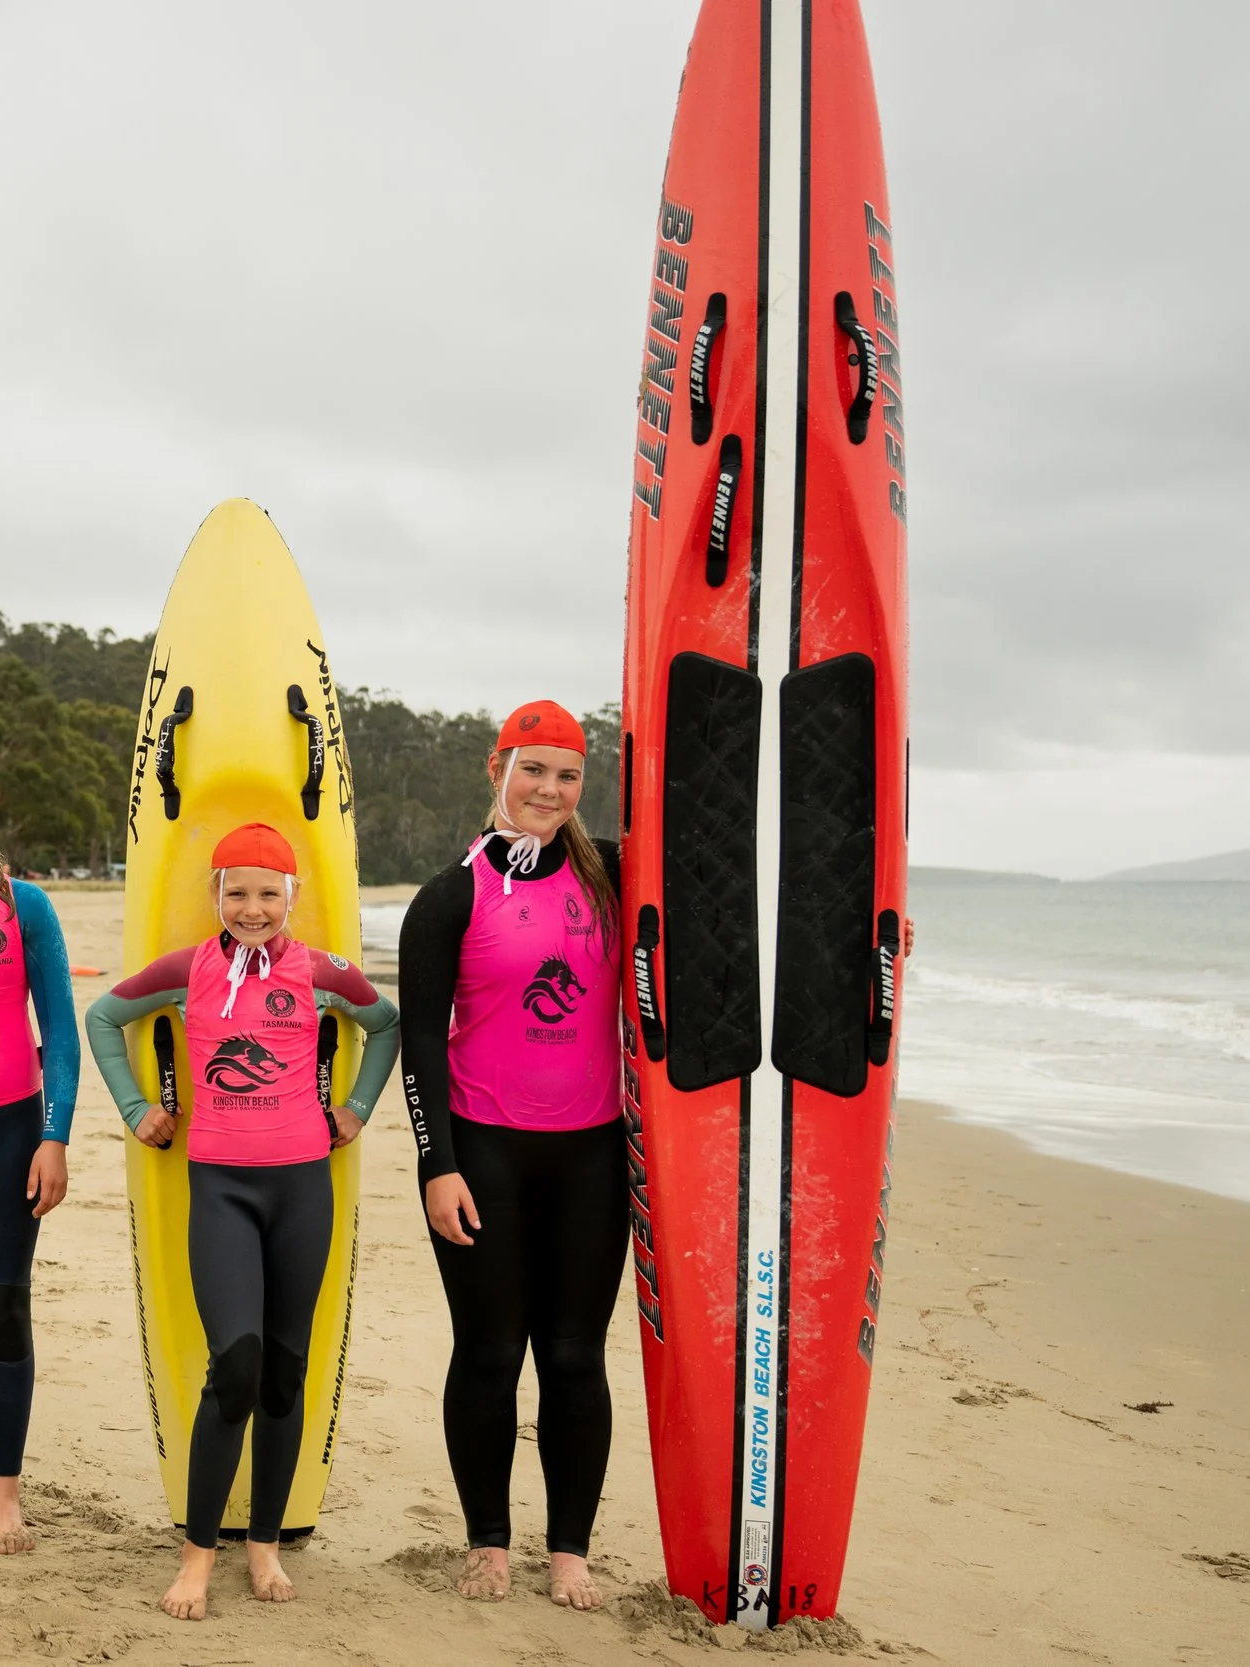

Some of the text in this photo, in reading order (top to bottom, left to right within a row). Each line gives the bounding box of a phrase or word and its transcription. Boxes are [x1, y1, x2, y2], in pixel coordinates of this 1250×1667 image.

[635, 198, 693, 521] BENNETT
[690, 325, 712, 404] BENNETT
[861, 324, 878, 402] BENNETT
[864, 200, 906, 525] BENNETT
[710, 472, 733, 551] BENNETT
[634, 946, 656, 1021] BENNETT
[880, 946, 898, 1021] BENNETT
[261, 1020, 303, 1029] TASMANIA
[212, 1095, 280, 1107] KINGSTON BEACH
[623, 1012, 664, 1344] BENNETT
[756, 1249, 775, 1316] S.L.S.C.
[753, 1327, 772, 1397] BEACH
[749, 1405, 770, 1508] KINGSTON
